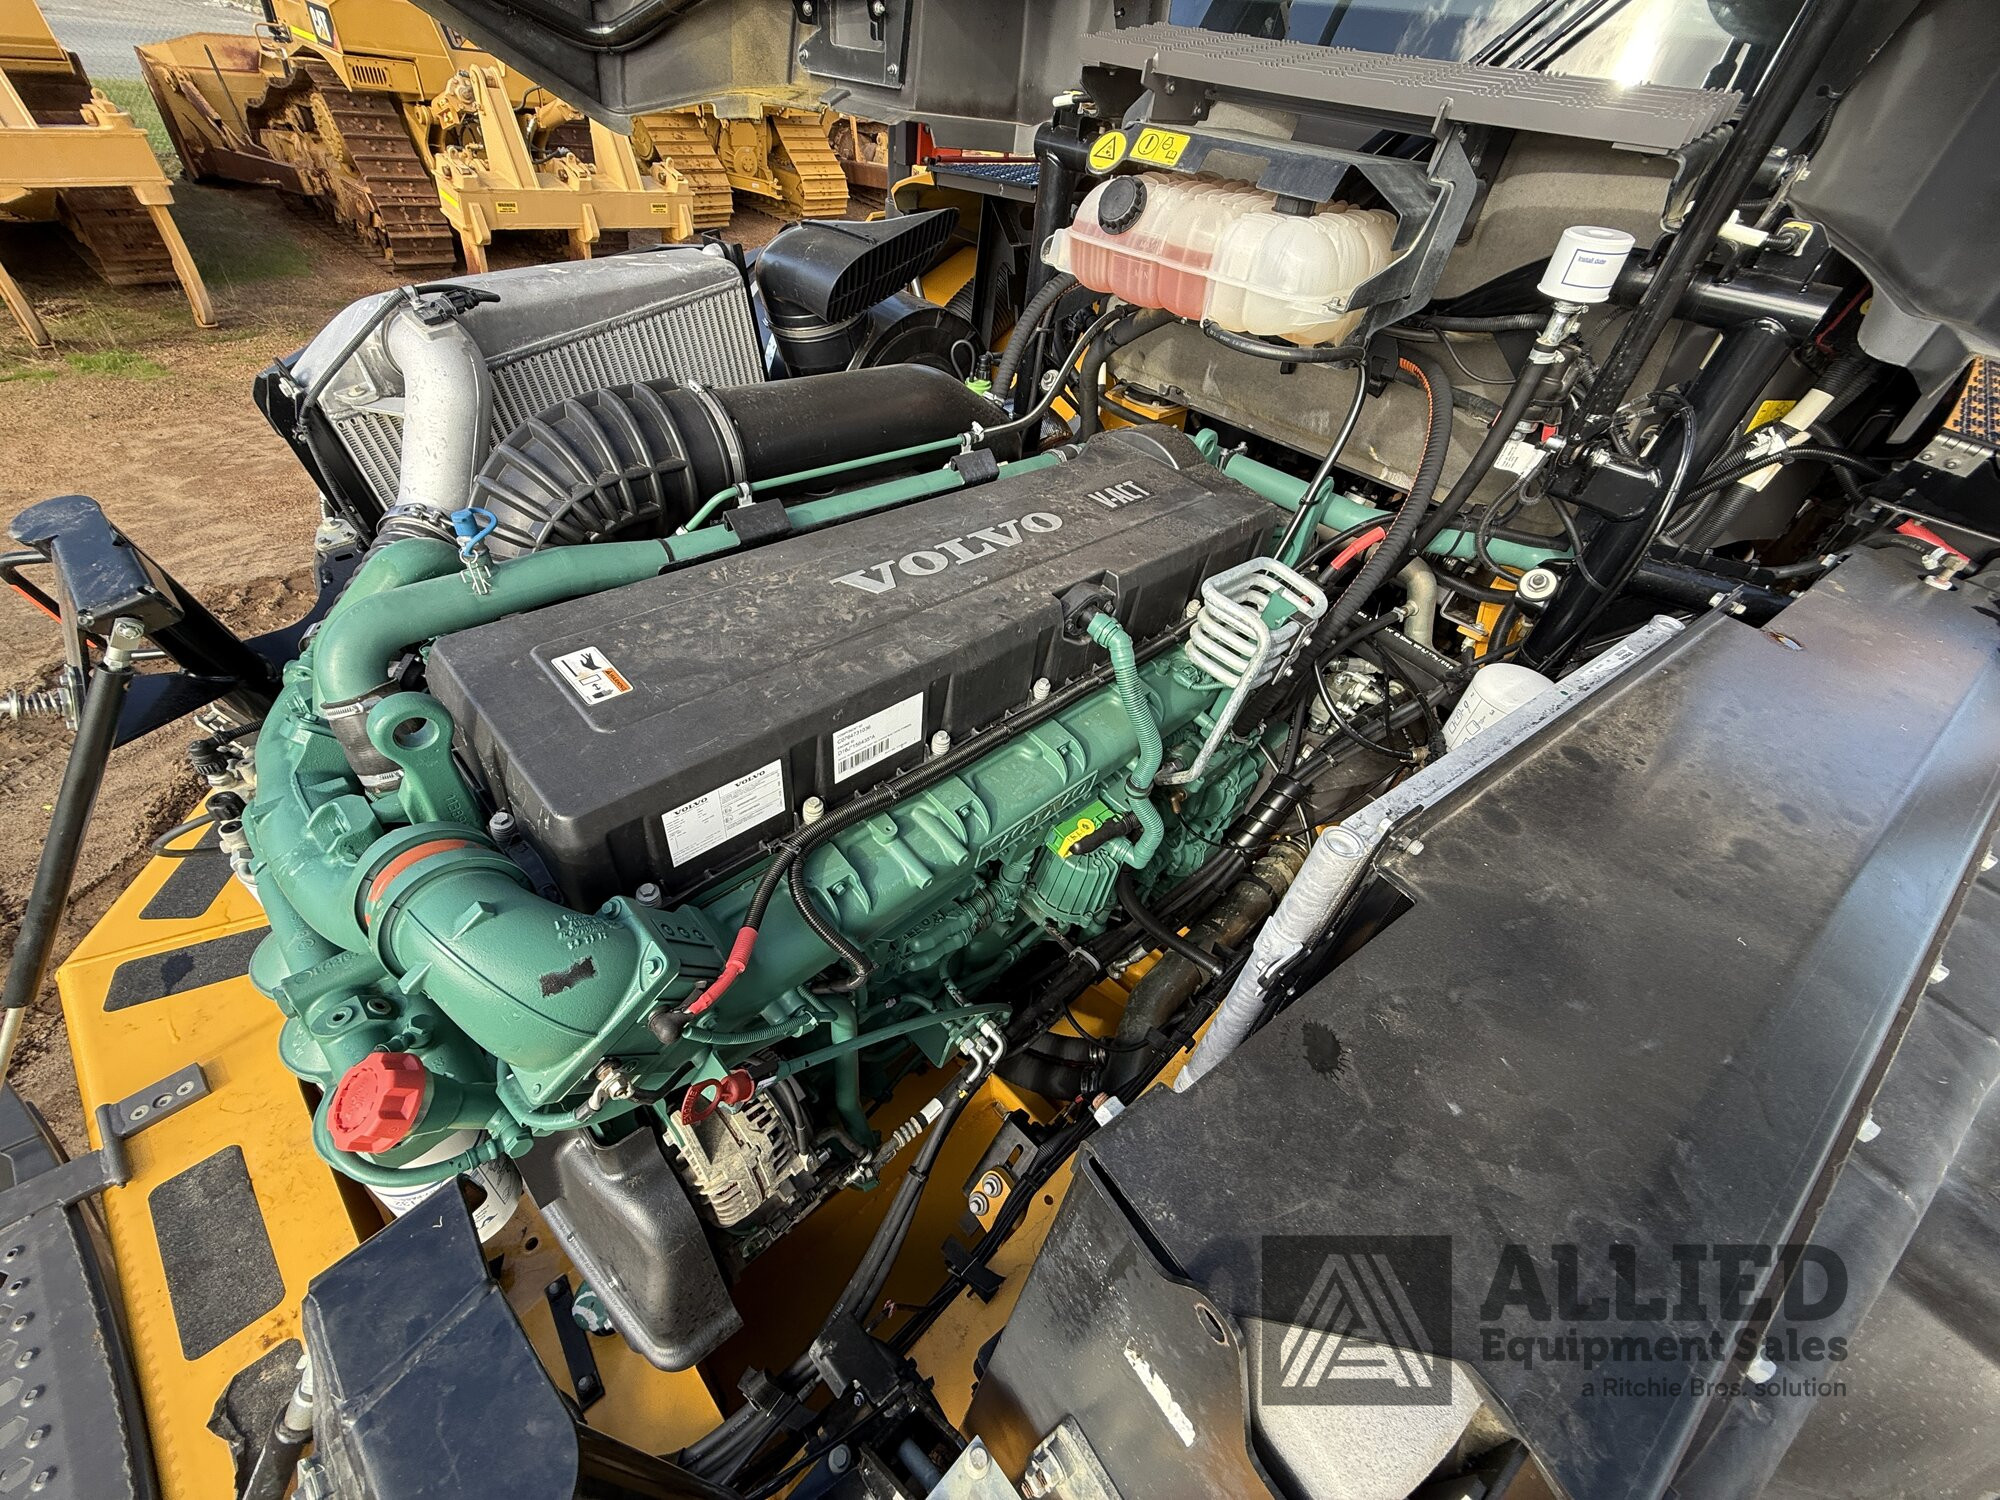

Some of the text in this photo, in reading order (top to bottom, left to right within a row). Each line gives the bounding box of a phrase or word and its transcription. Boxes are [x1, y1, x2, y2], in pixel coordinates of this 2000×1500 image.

[309, 6, 332, 42] CAT
[1578, 255, 1595, 264] Install
[1088, 480, 1150, 509] V-ACT
[829, 512, 1063, 595] VOLVO
[735, 770, 766, 788] VOLVO
[674, 797, 708, 815] VOLVO
[683, 1090, 698, 1124] ENGINE
